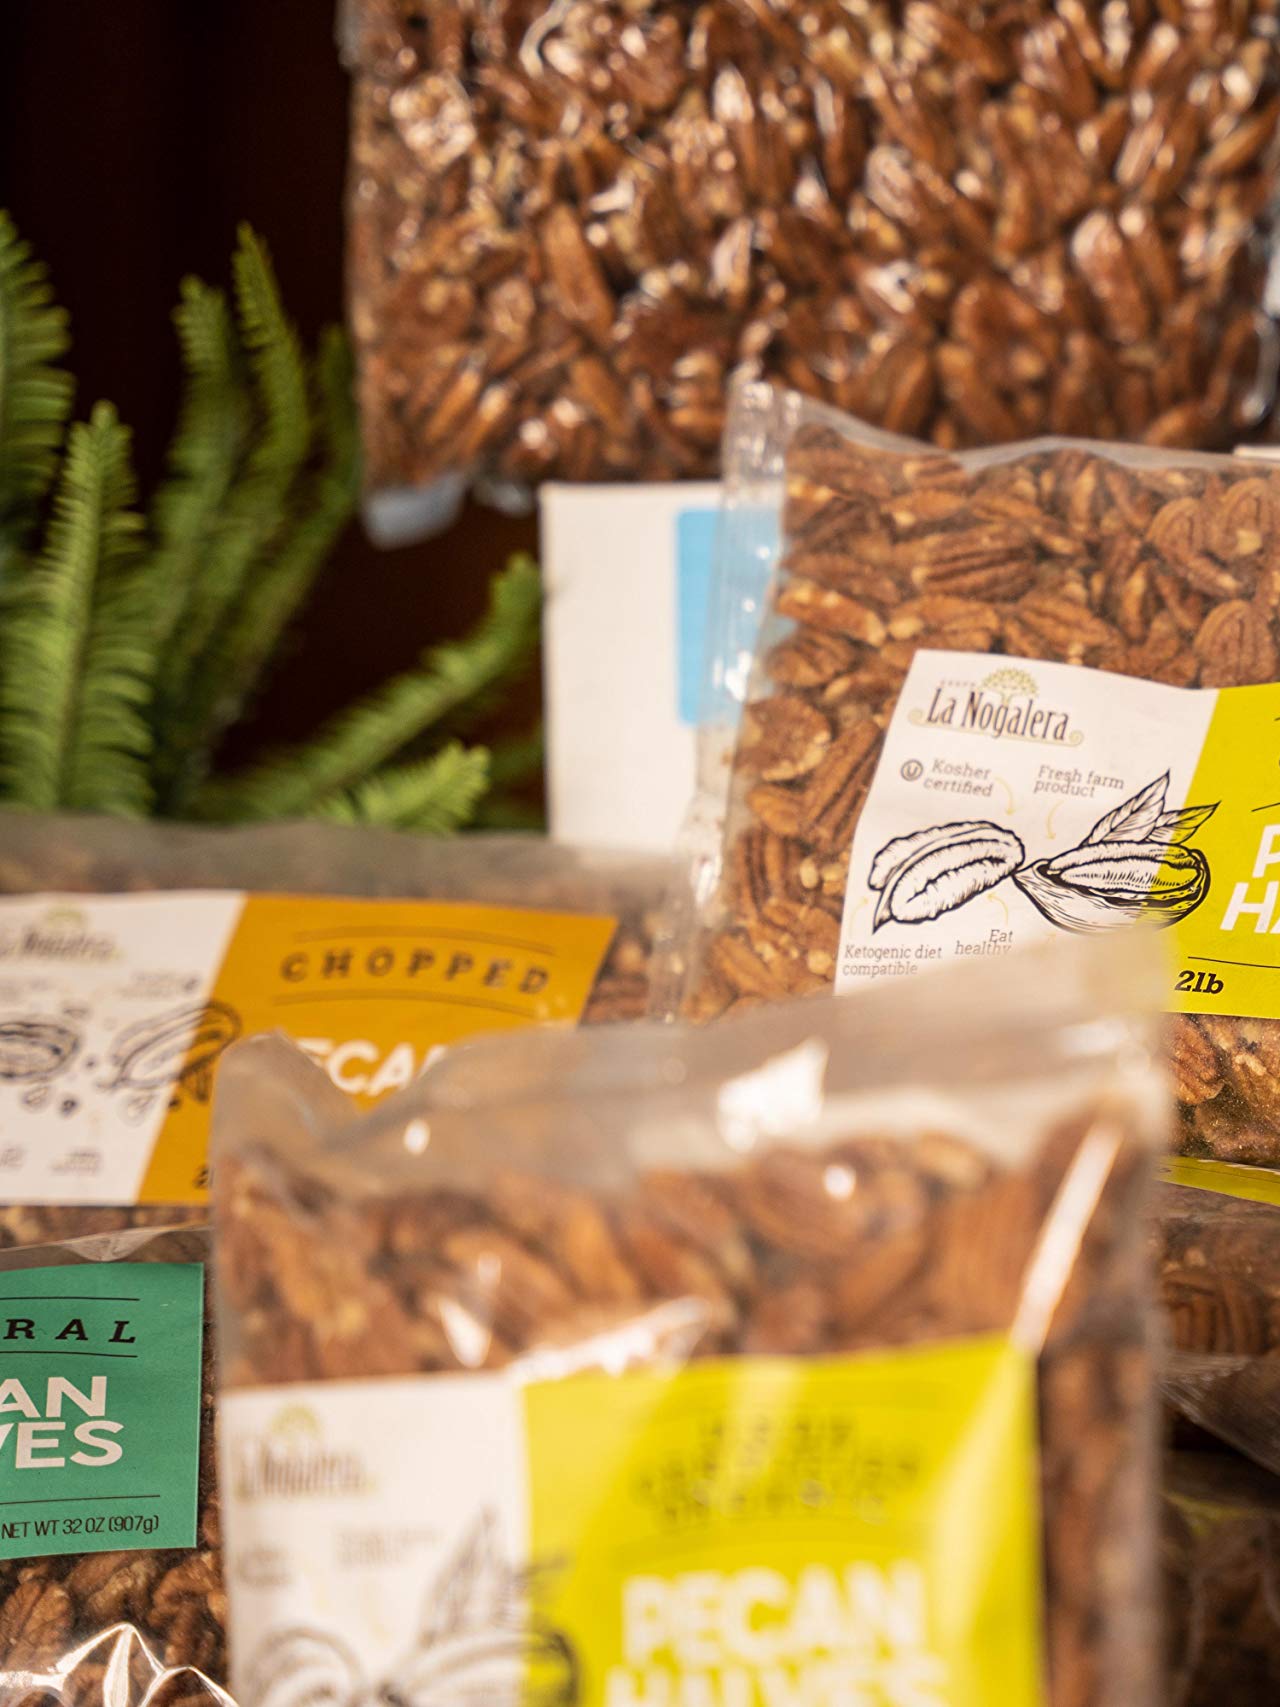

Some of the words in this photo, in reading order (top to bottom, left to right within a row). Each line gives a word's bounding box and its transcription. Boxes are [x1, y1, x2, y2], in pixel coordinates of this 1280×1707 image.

[927, 688, 956, 725] La
[961, 691, 1069, 739] Nogalera
[932, 759, 991, 780] Kosher
[1038, 765, 1083, 783] Fresh
[1087, 770, 1125, 790] farm
[924, 777, 994, 797] certified
[1033, 779, 1095, 798] product
[989, 929, 1013, 943] Eat
[844, 945, 911, 962] Ketogenic
[915, 945, 942, 959] diet
[280, 946, 552, 996] CHOPPED
[843, 961, 918, 978] compatible
[1174, 969, 1225, 996] 2lb
[1, 1521, 28, 1540] NET
[34, 1519, 60, 1537] WT
[62, 1518, 83, 1535] 32
[85, 1516, 106, 1534] OZ
[108, 1514, 160, 1535] (907g)
